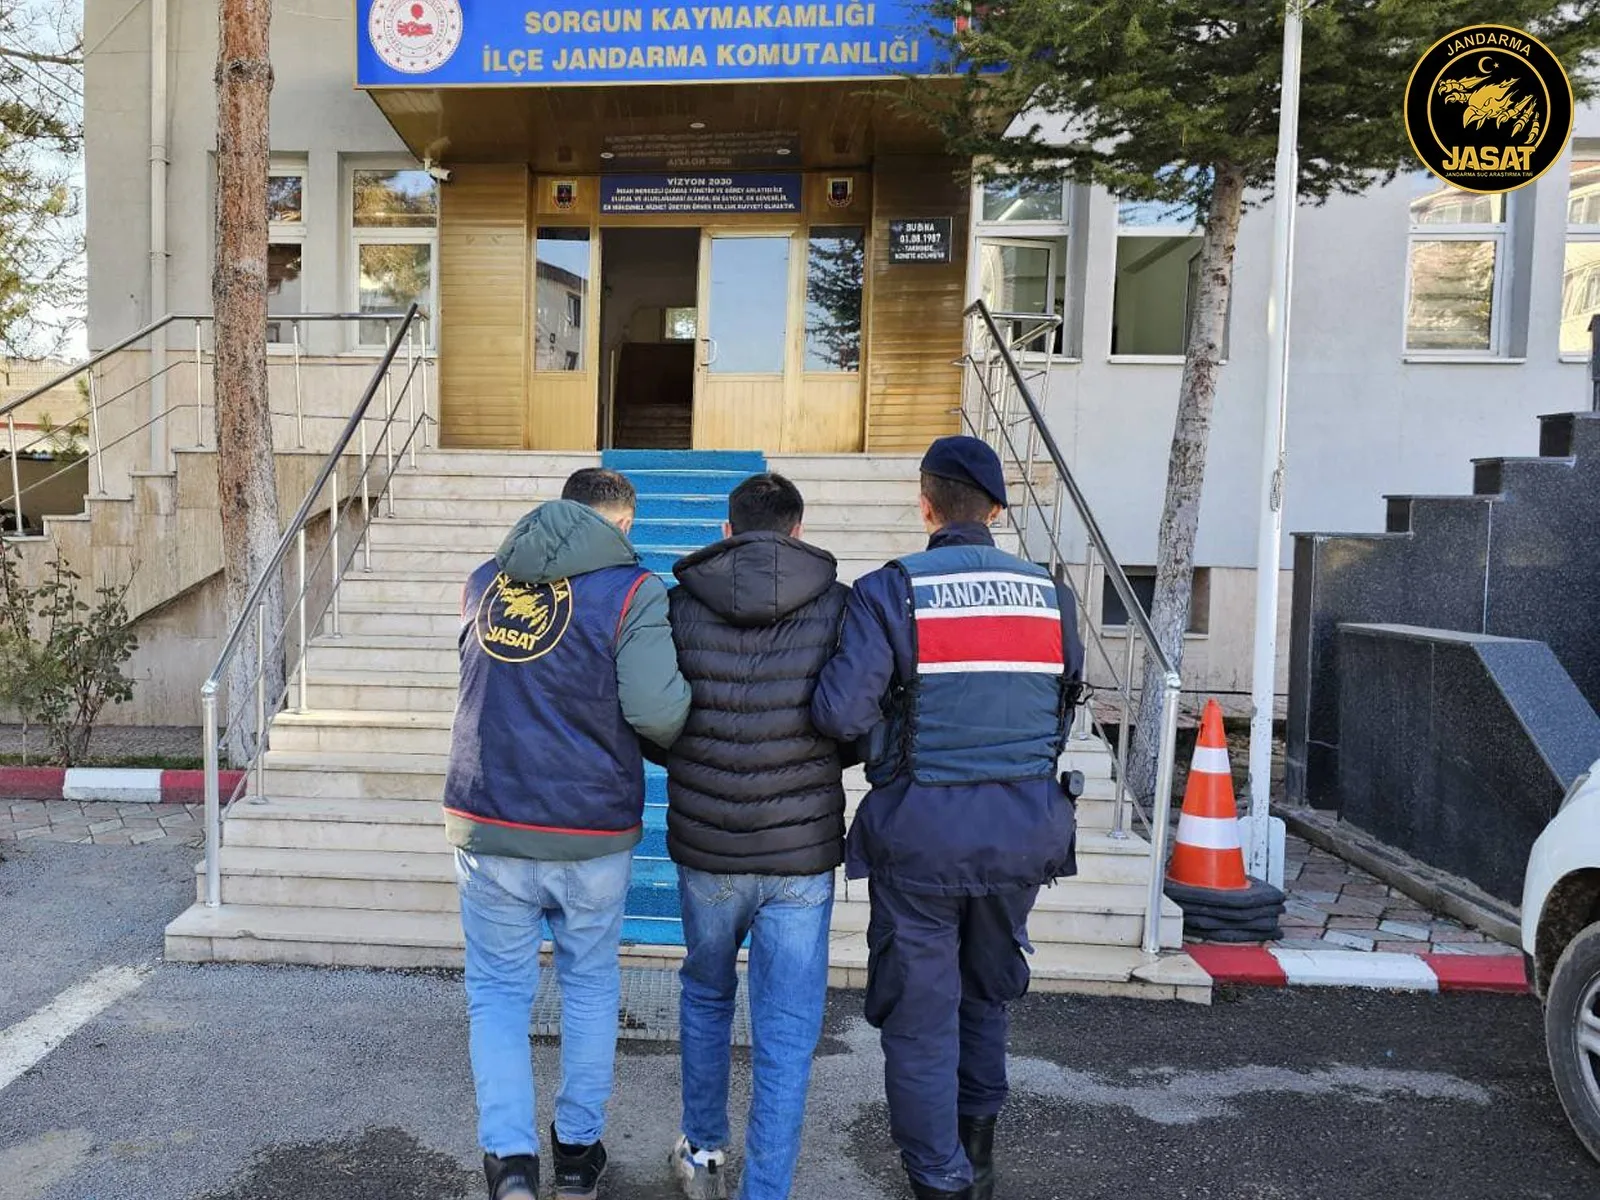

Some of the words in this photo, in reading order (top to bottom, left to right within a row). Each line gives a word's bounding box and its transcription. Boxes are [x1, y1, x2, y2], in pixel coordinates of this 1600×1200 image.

[525, 8, 642, 34] SORGUN
[652, 0, 875, 31] KAYMAKAMLIĞI
[483, 45, 543, 76] İLÇE
[552, 45, 707, 70] JANDARMA
[717, 36, 919, 66] KOMUTANLIĞI
[667, 177, 705, 186] VİZYON
[929, 580, 1046, 608] JANDARMA
[485, 626, 538, 650] JASAT
